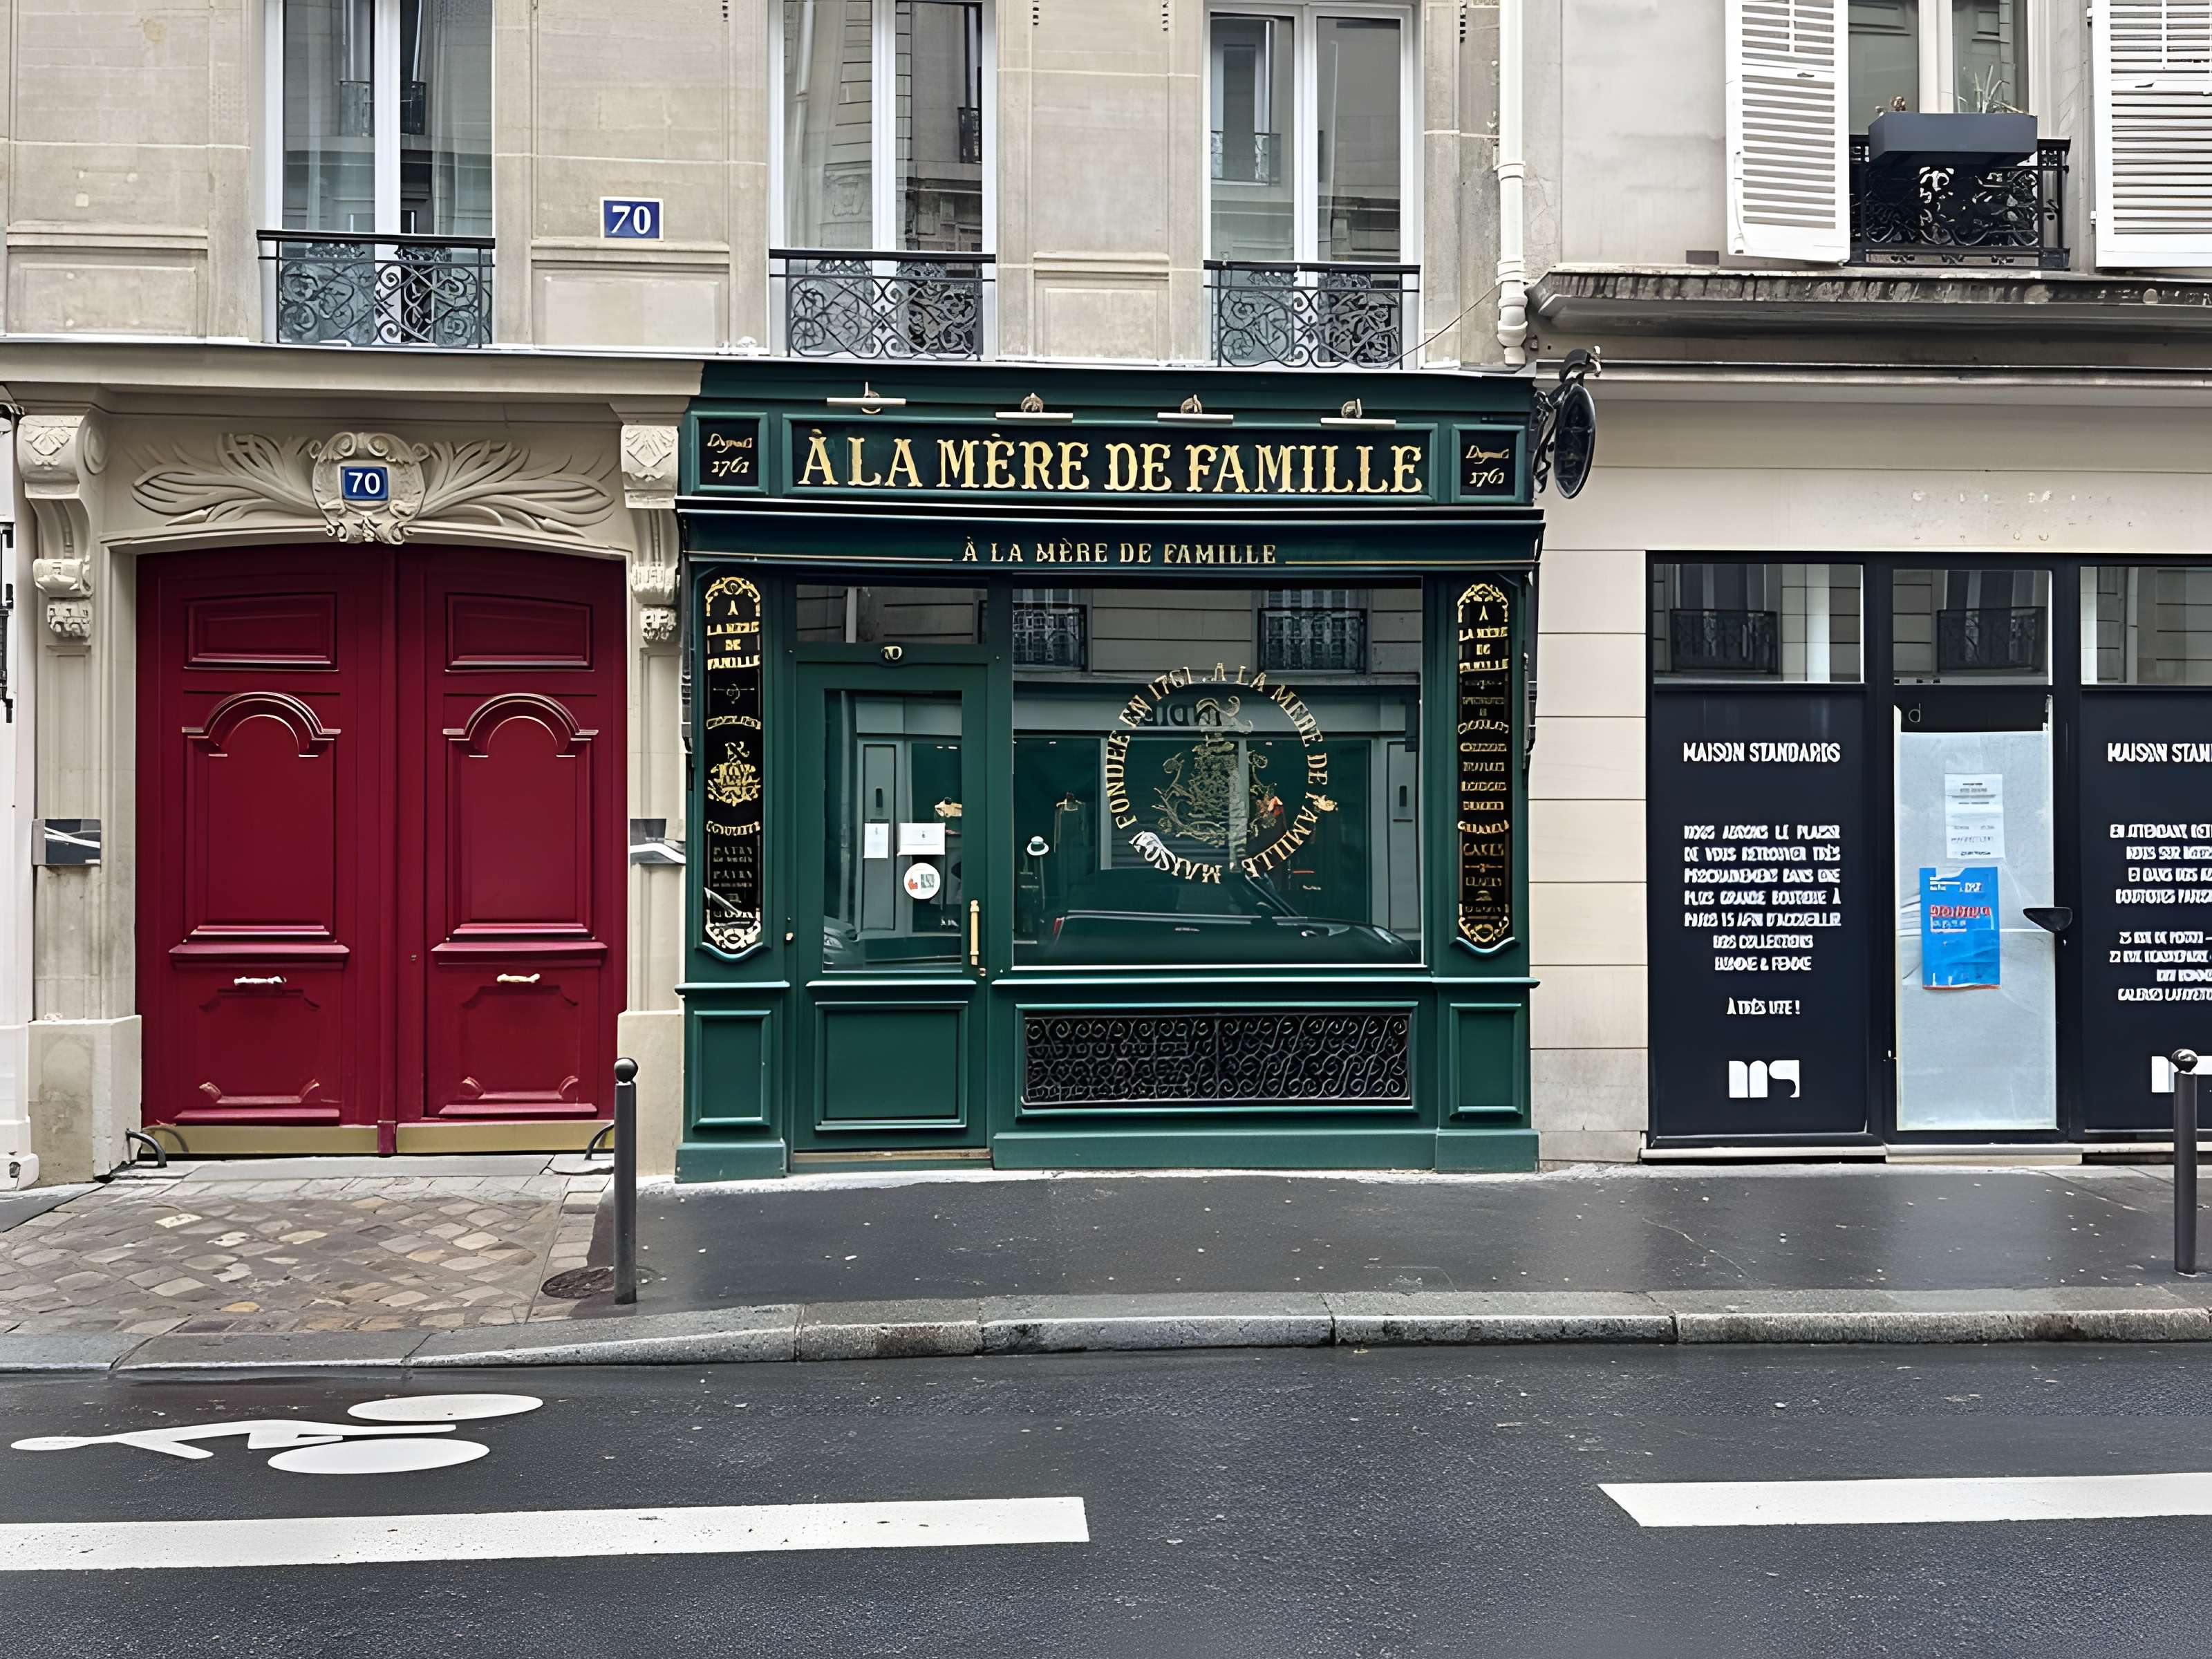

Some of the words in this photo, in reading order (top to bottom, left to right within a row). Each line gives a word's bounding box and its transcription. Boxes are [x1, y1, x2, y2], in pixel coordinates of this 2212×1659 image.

[611, 205, 651, 235] 70
[797, 429, 839, 485] À
[847, 436, 924, 487] LA
[935, 433, 1090, 491] MÈRE
[1104, 442, 1172, 491] DE
[1185, 444, 1423, 493] FAMILLE
[348, 471, 380, 495] 70
[962, 536, 979, 562] À
[991, 543, 1024, 562] LA
[1036, 538, 1108, 563] MÈRE
[1120, 543, 1152, 563] DE
[1164, 543, 1277, 564] FAMILLE
[1683, 741, 1745, 763] MAISON
[1306, 752, 1328, 785] DE
